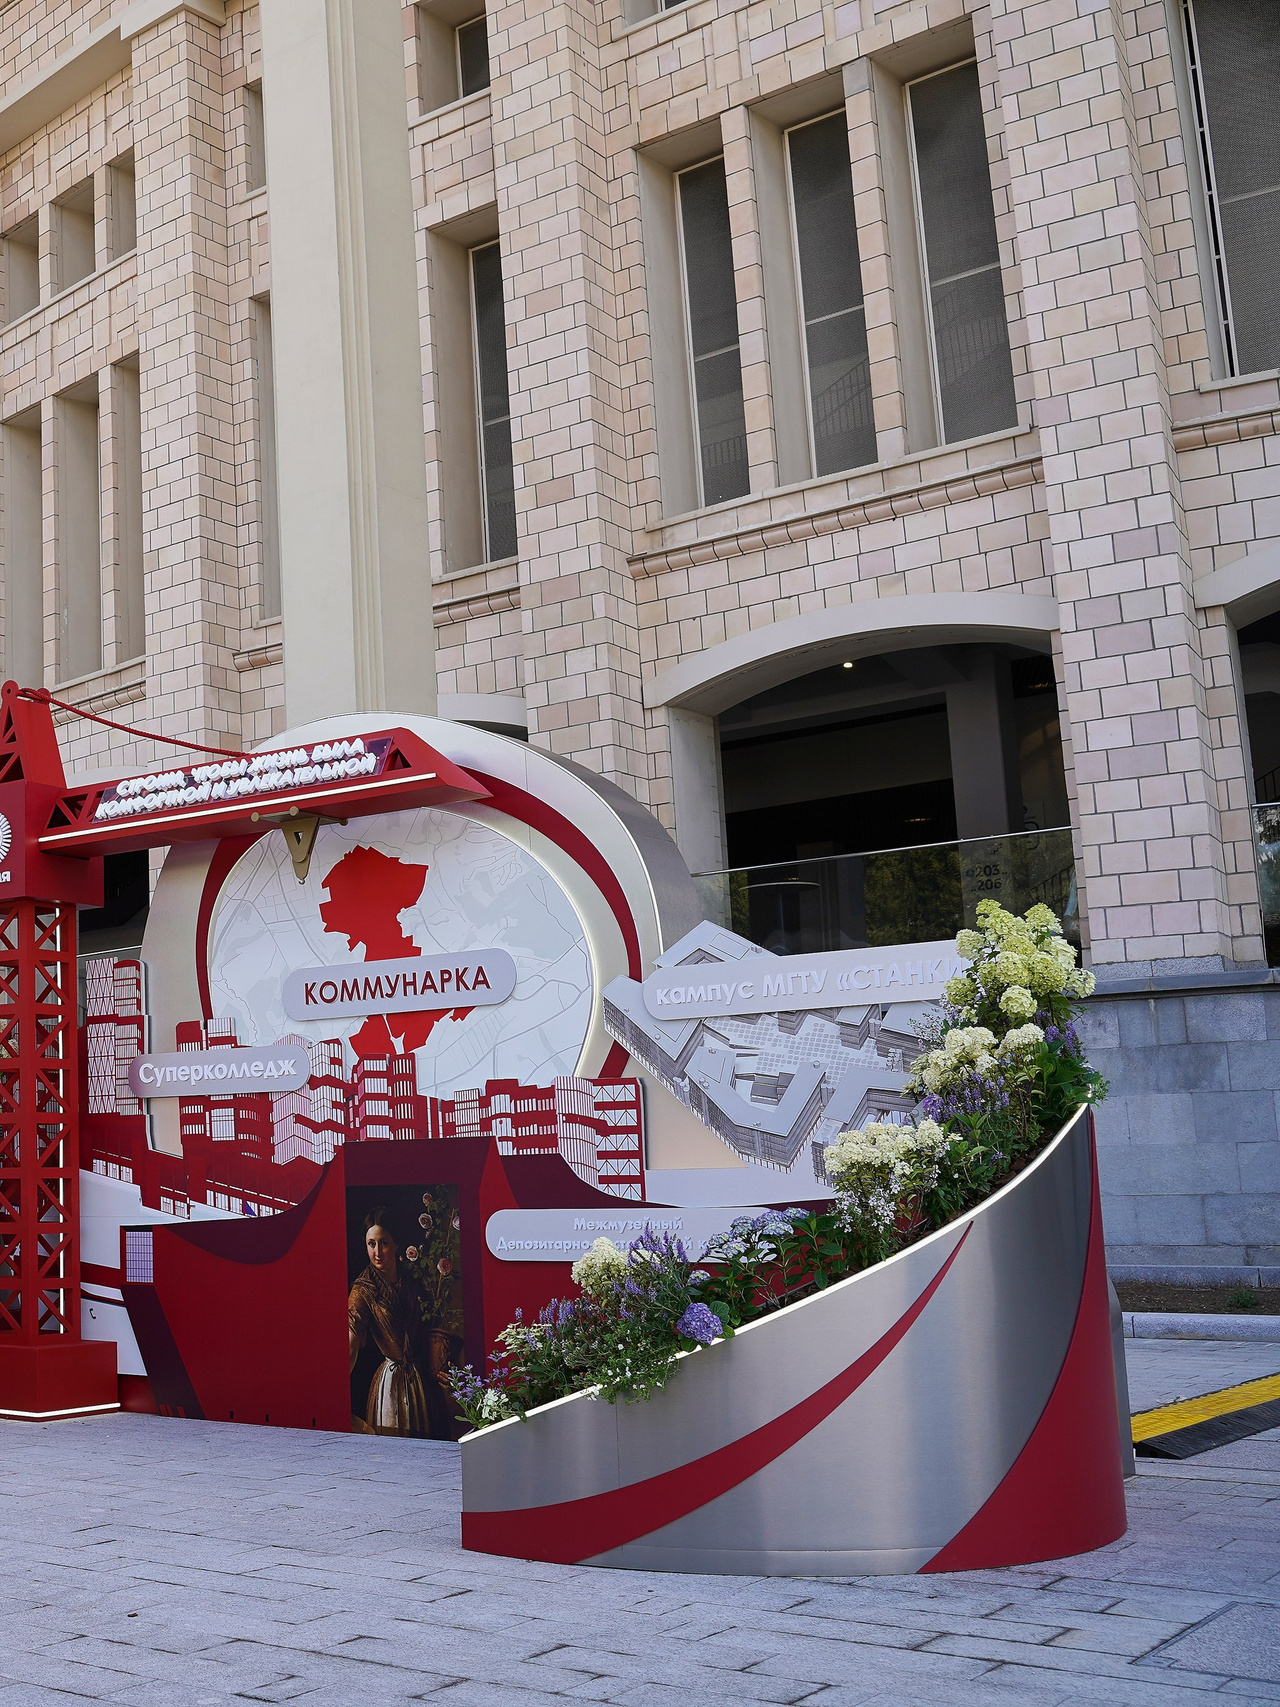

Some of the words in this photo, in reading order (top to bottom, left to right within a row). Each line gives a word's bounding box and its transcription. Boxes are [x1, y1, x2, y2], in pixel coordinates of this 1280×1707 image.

[191, 759, 248, 783] ЧТОБЫ
[247, 748, 309, 775] ЖИЗНЬ
[311, 738, 365, 763] БЫЛА
[95, 781, 212, 819] КОМФОРТНОЙ
[211, 780, 228, 799] И
[226, 753, 378, 797] УВЛЕКАТЕЛЬНОЙ
[304, 965, 492, 1005] КОММУНАРКА
[656, 981, 754, 1005] кампус
[762, 969, 828, 997] МГТУ
[836, 957, 966, 991] «СТАНКИ
[138, 1056, 298, 1087] Суперколледж
[573, 1216, 683, 1233] Межмузейный
